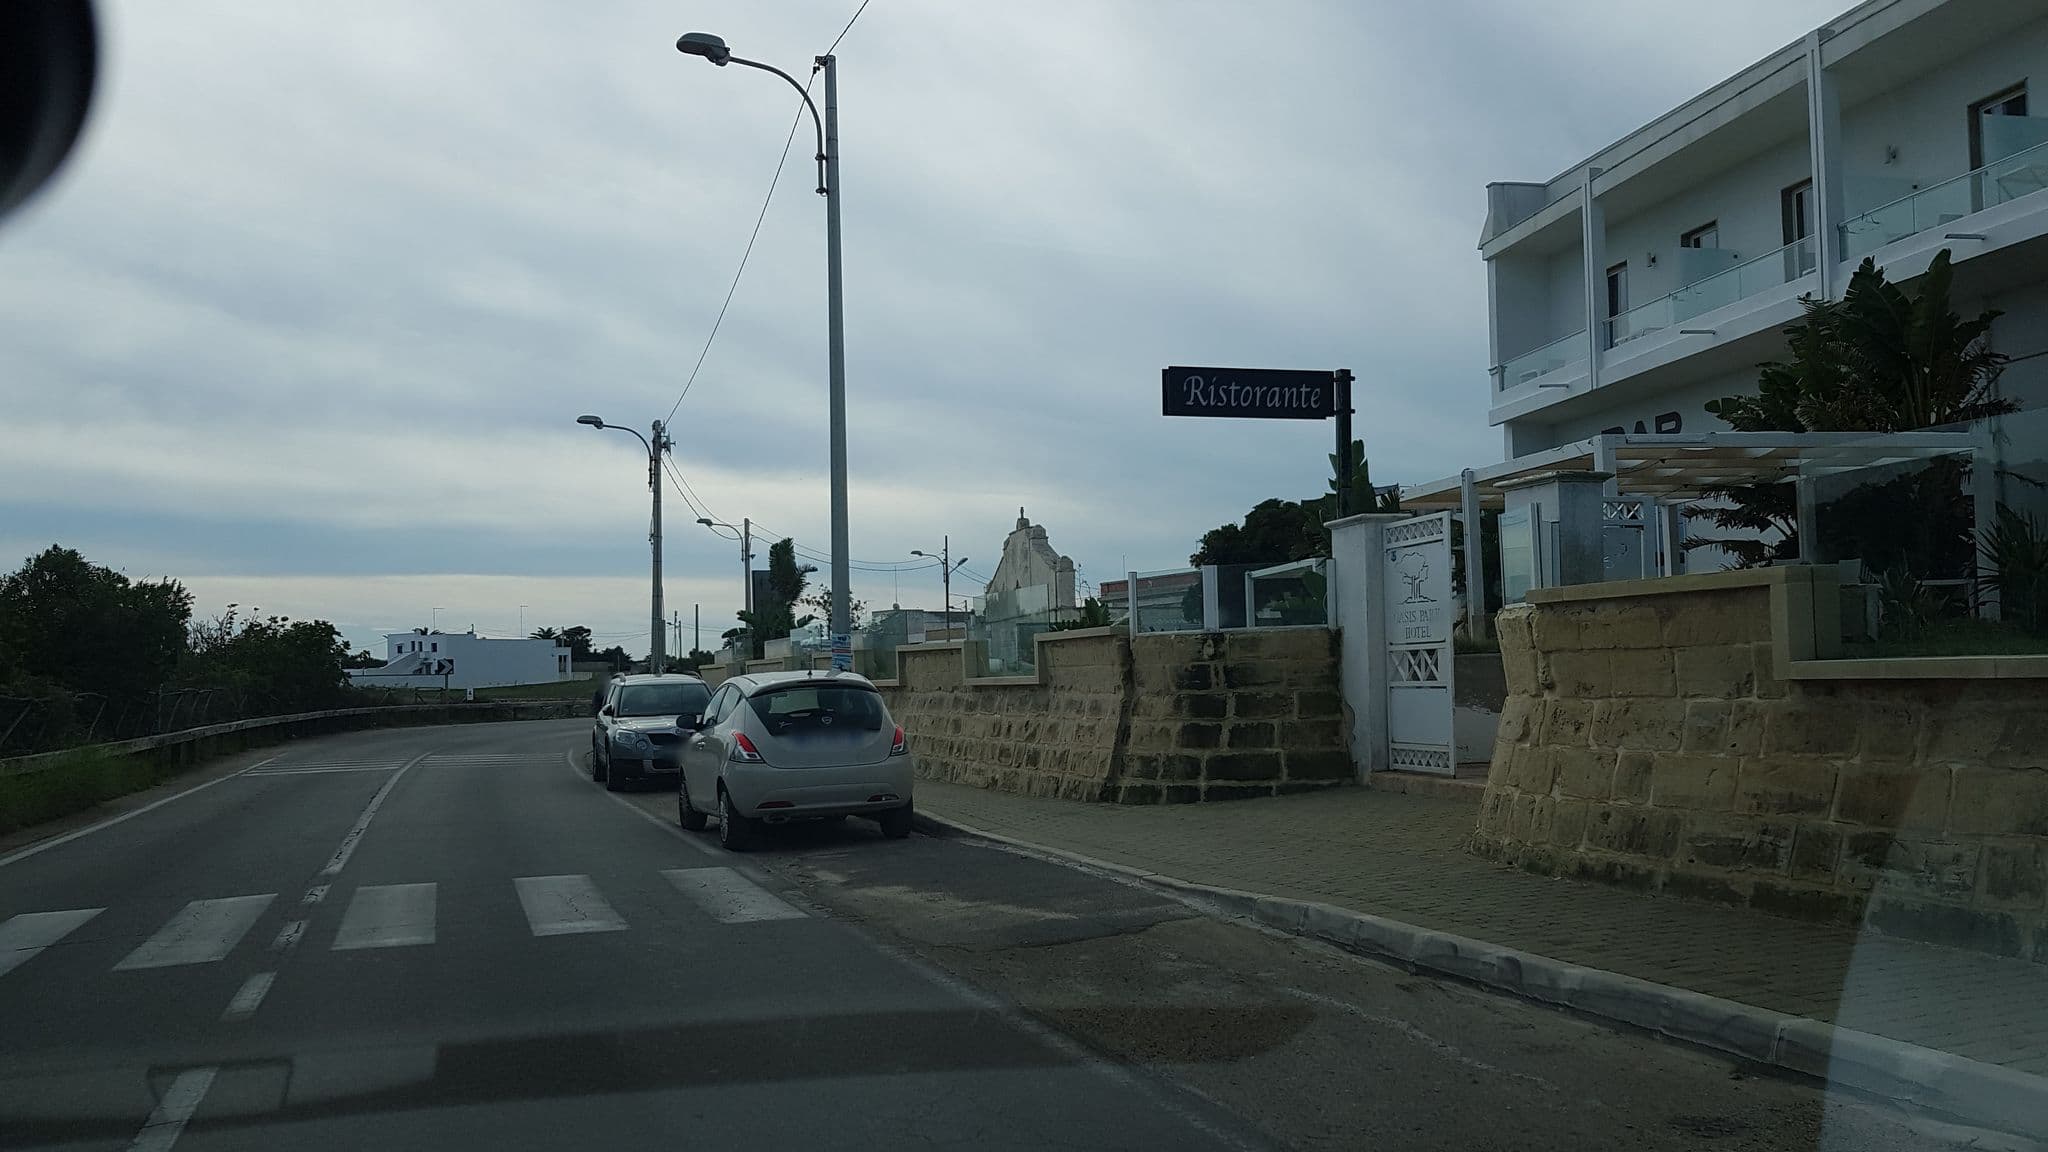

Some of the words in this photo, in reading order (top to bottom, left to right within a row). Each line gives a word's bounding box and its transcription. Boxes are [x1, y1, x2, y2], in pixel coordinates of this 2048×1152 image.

[1183, 375, 1322, 409] Ristorante
[1394, 610, 1417, 623] ASIS
[1405, 626, 1432, 639] HOTEL
